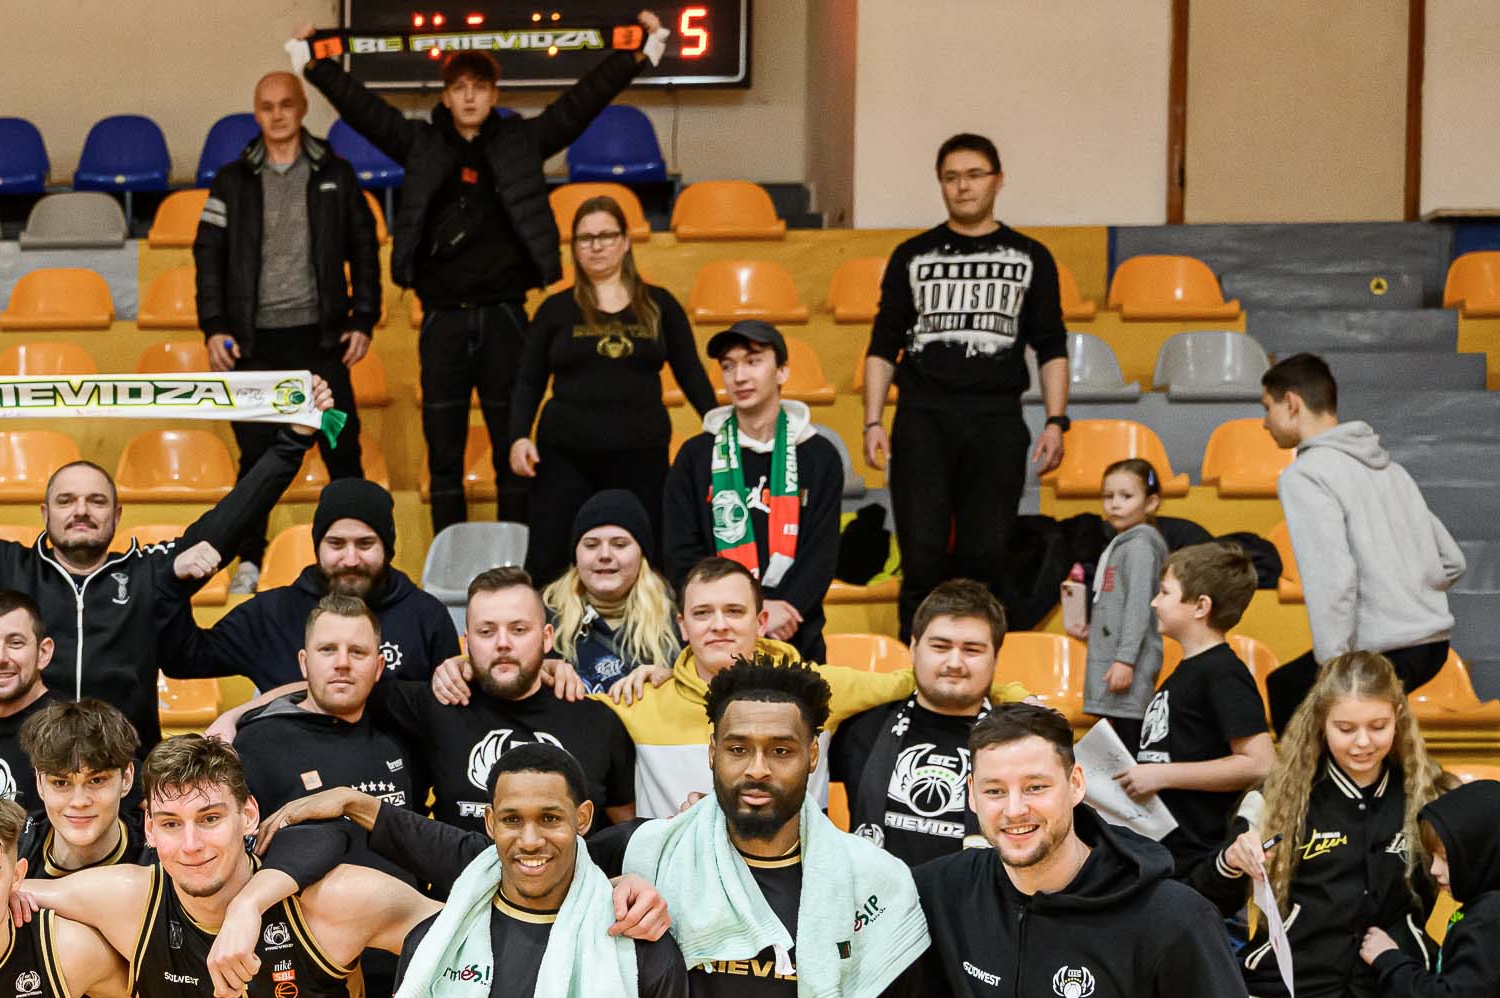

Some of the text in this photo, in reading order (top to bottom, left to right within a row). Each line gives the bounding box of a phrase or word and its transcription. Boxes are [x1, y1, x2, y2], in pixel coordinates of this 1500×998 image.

[412, 30, 602, 52] PRIEVIDZA
[679, 8, 708, 56] 5
[918, 283, 1025, 315] ADVISORY
[926, 754, 960, 768] BC
[885, 811, 965, 839] RIEVIDZ
[274, 960, 292, 972] niké
[274, 971, 294, 982] SBL
[962, 961, 1001, 986] SÜDWEST
